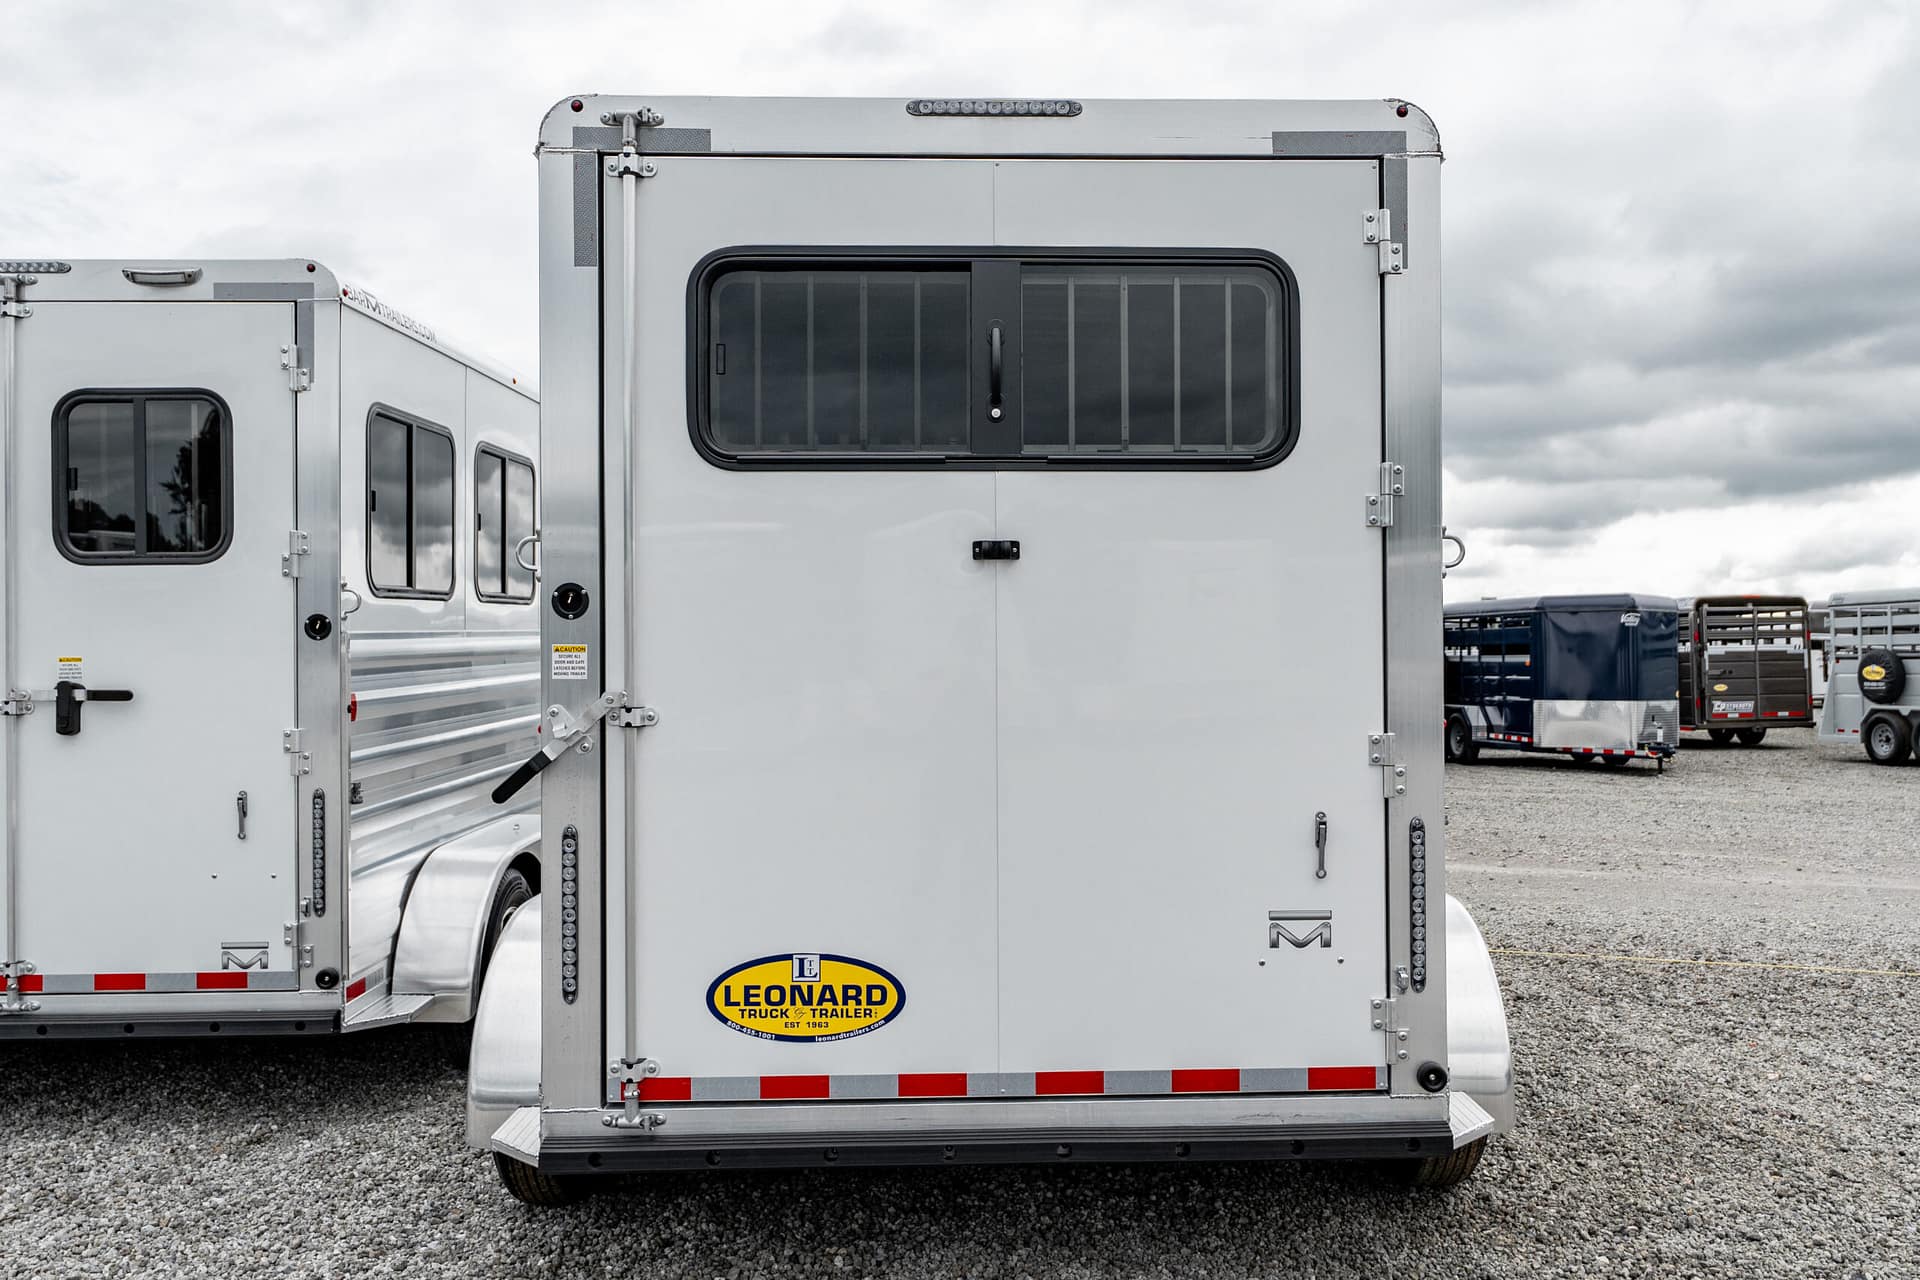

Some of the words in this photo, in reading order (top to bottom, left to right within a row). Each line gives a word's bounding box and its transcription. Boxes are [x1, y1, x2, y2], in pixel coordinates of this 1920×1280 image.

[724, 984, 888, 1007] LEONARD
[738, 1007, 790, 1019] TRUCK
[810, 1007, 873, 1019] TRAILER
[784, 1021, 800, 1029] EST
[806, 1021, 829, 1029] 1963
[815, 1019, 886, 1042] leonardtrailers.com
